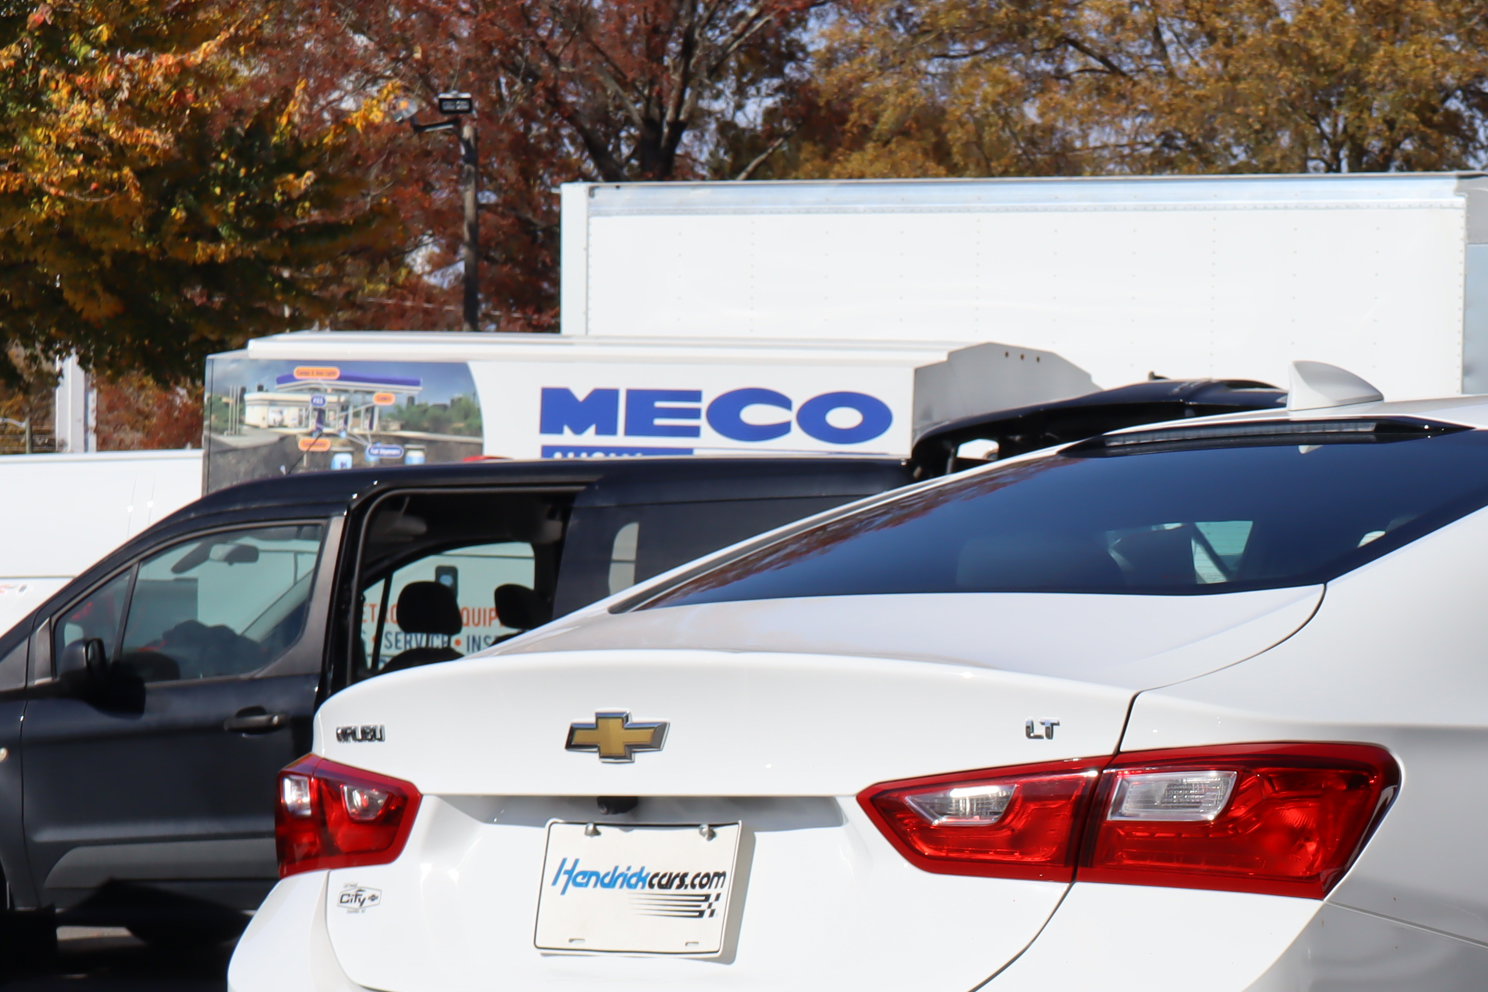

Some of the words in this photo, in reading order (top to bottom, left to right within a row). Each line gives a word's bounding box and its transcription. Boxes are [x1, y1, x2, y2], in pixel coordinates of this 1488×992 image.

[539, 386, 894, 445] MECO
[1025, 719, 1060, 740] LT
[551, 857, 727, 896] Hendrickcars.com
